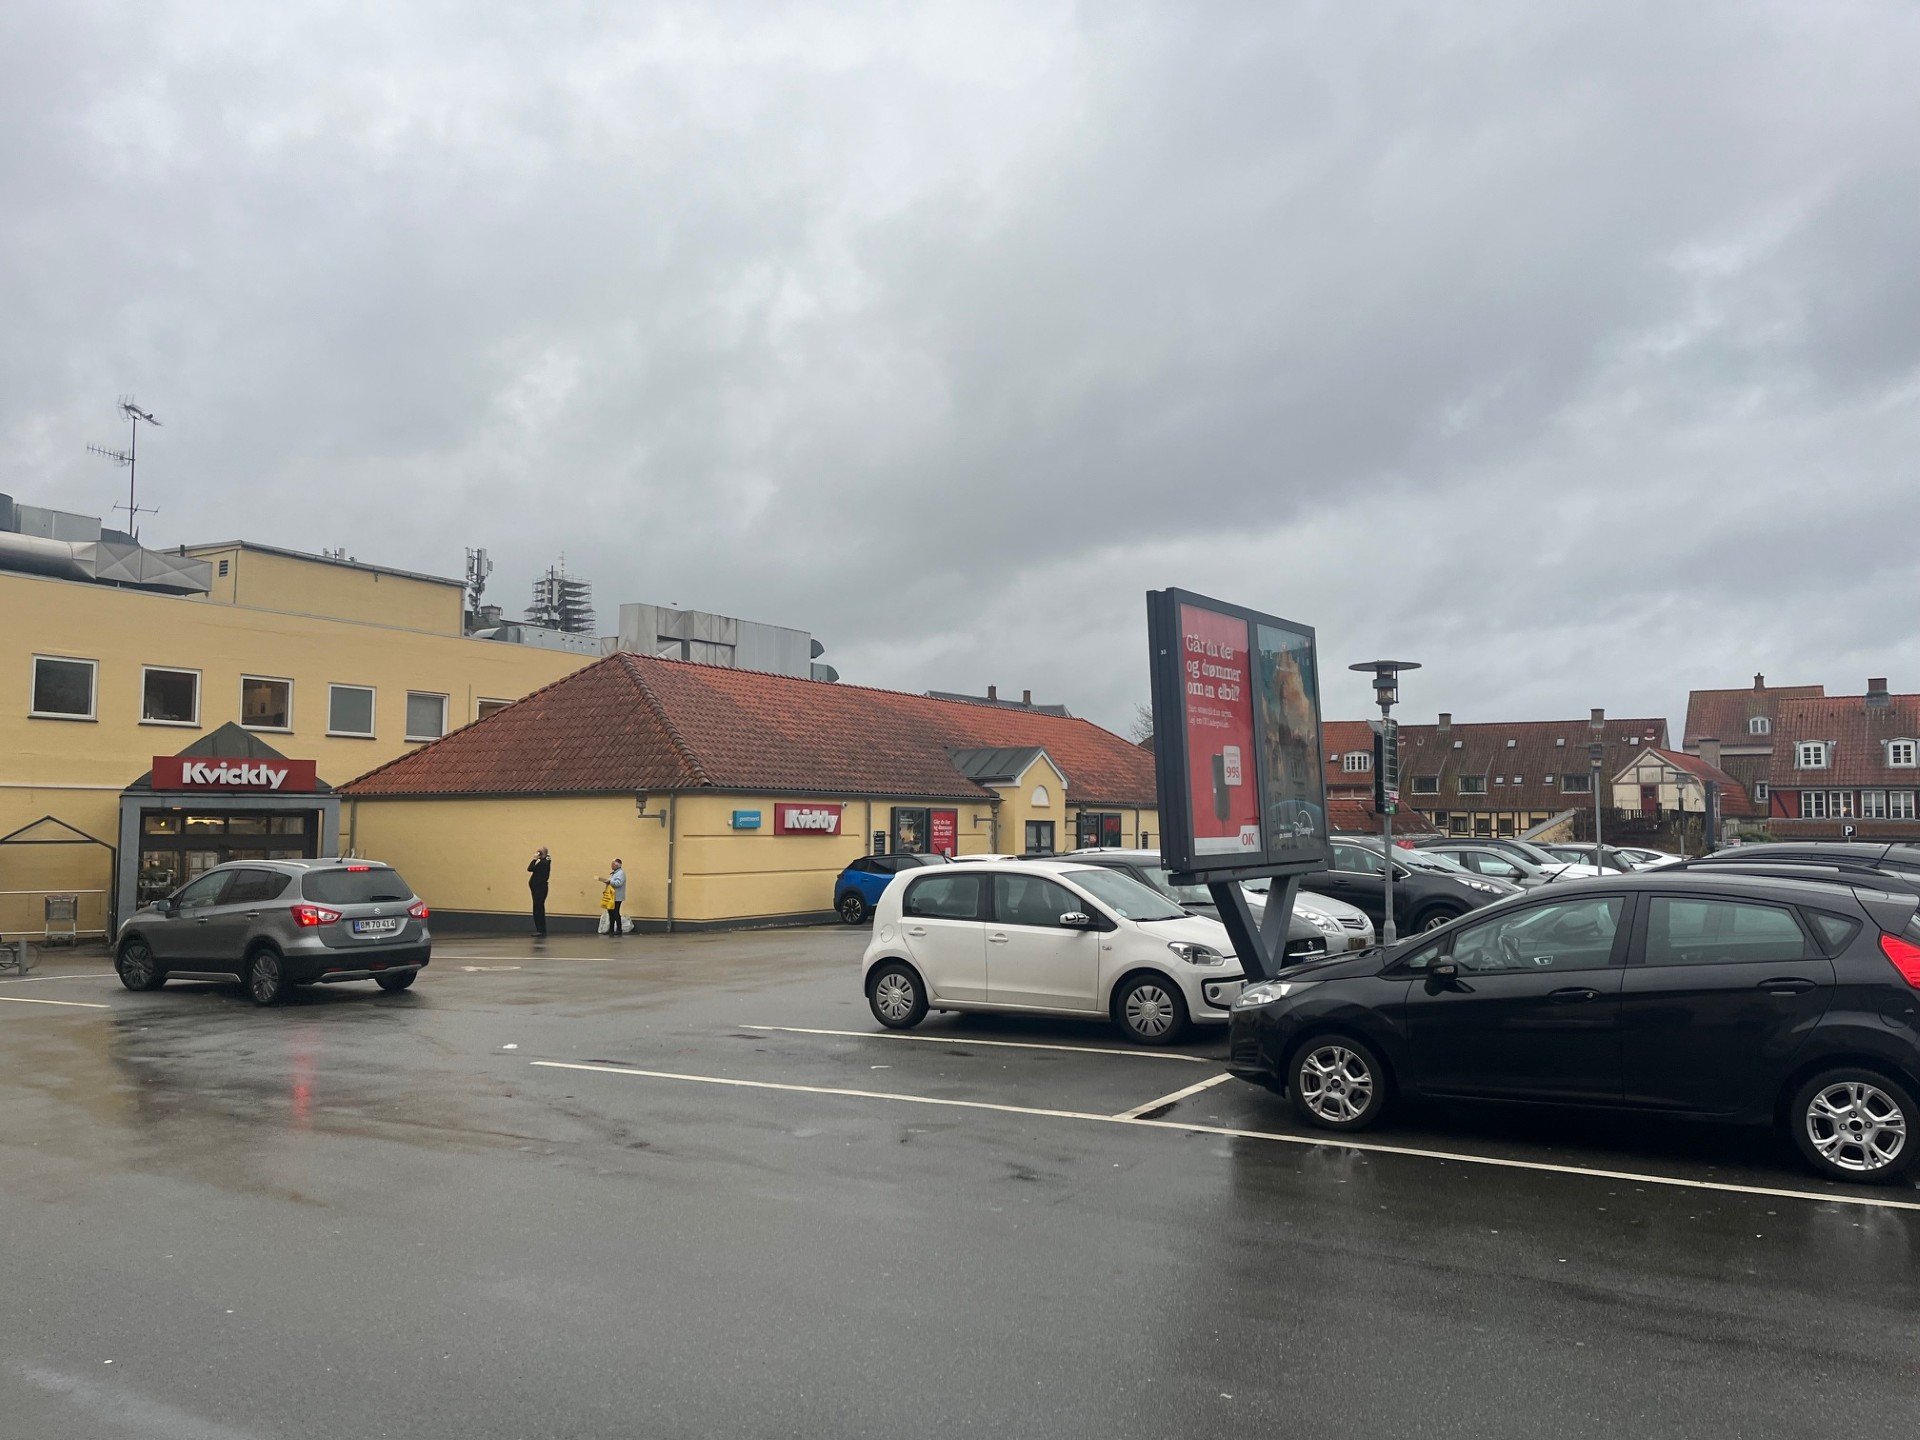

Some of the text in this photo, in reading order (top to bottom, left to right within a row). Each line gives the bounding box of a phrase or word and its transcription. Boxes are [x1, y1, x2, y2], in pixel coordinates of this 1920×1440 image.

[1186, 634, 1234, 660] Går du der
[1187, 660, 1200, 678] og
[1187, 682, 1204, 696] om
[1205, 684, 1215, 698] en
[182, 762, 288, 790] Kvickly
[784, 809, 839, 833] Kvickly
[1242, 833, 1255, 846] OK
[1845, 826, 1853, 836] P
[371, 920, 381, 928] 70
